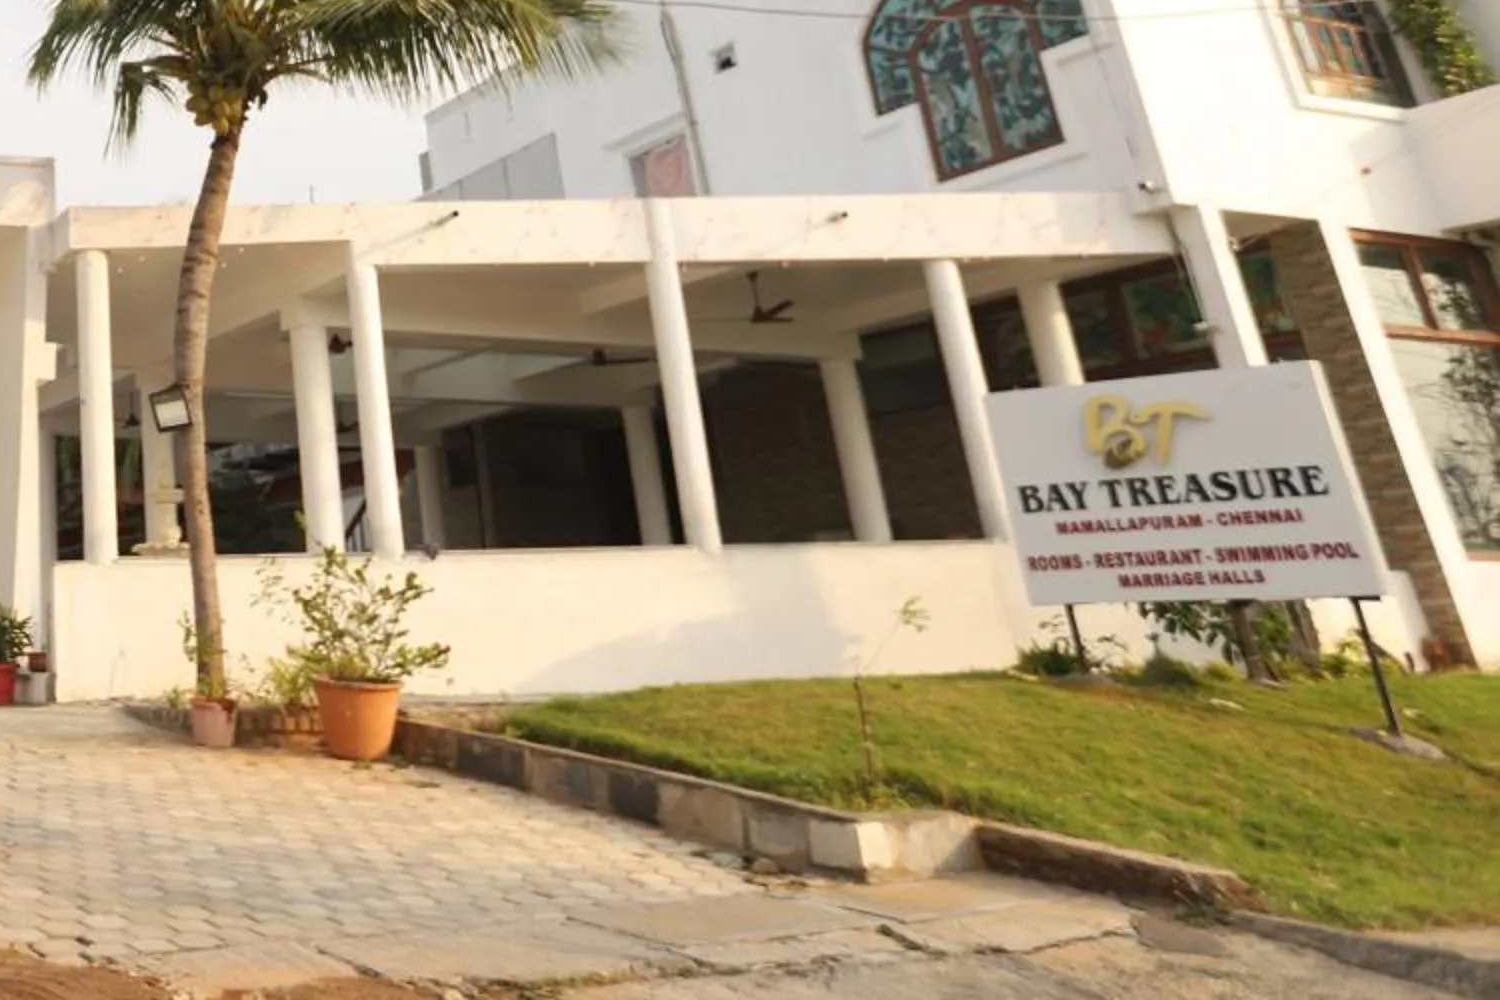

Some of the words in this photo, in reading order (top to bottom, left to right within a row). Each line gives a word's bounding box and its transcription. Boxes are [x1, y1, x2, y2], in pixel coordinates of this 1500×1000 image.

[1018, 480, 1090, 515] BAY
[1098, 465, 1330, 509] TREASURE
[1055, 513, 1204, 536] MAMALLAPURAM
[1217, 508, 1305, 528] CHENNAI
[1027, 554, 1083, 572] ROOMS
[1094, 547, 1202, 569] RESTAURANT
[1215, 543, 1310, 564] SWIMMING
[1312, 542, 1360, 560] POOL
[1119, 570, 1207, 589] MARRIAGE
[1208, 568, 1266, 586] HALLS
